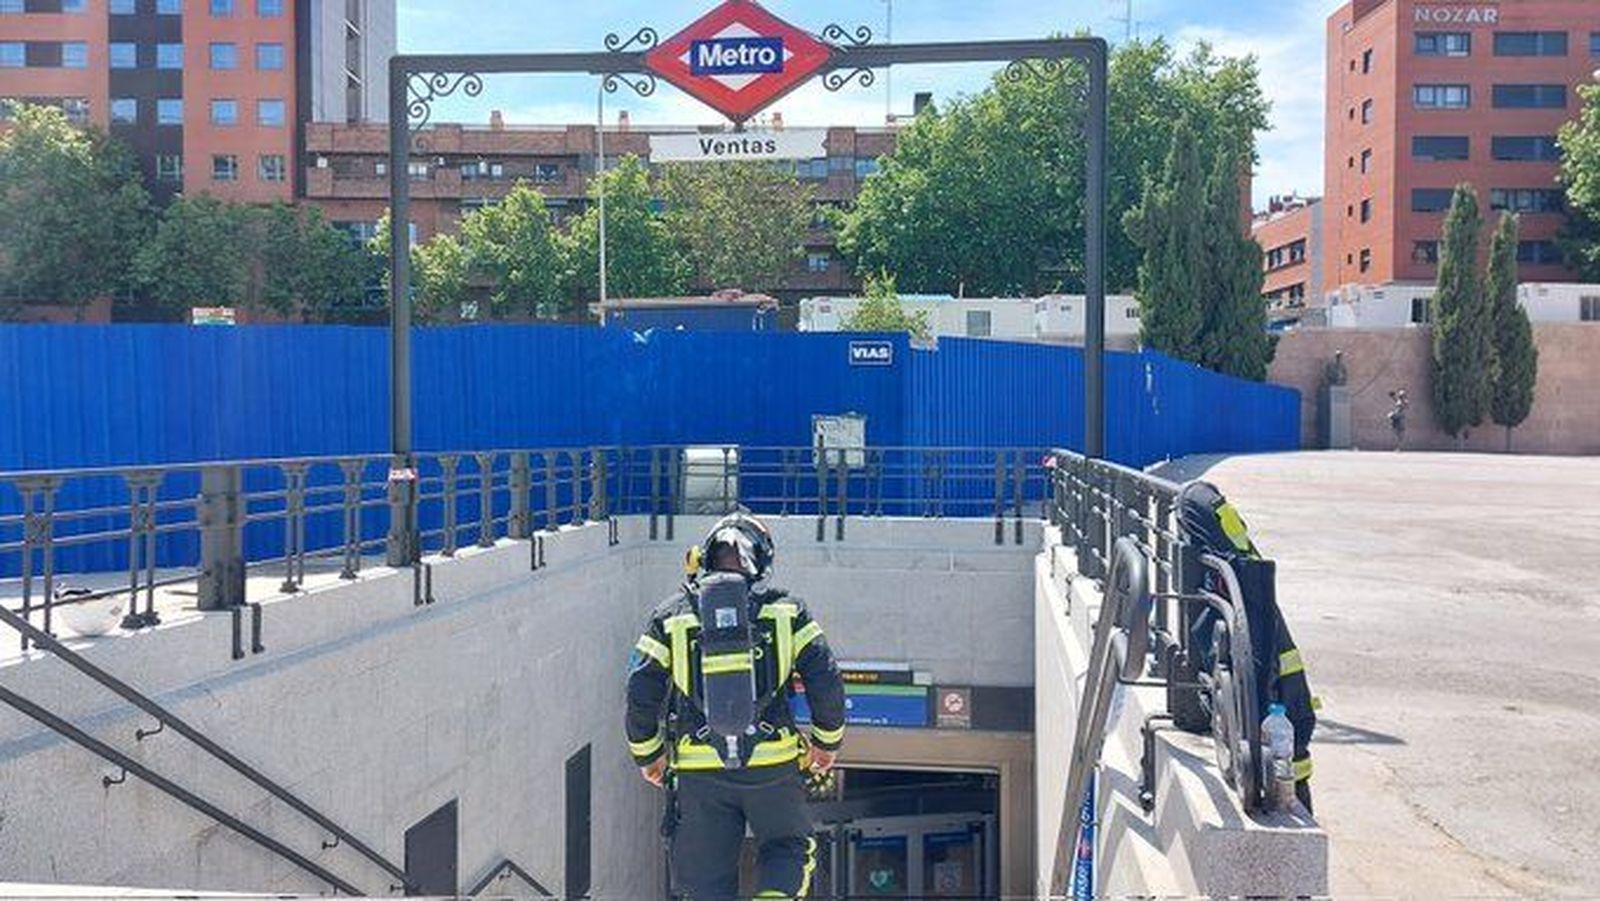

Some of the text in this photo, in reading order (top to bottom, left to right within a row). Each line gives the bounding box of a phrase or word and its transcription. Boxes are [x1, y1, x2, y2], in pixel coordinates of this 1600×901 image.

[1415, 7, 1498, 23] NOZAR
[699, 43, 776, 67] Metro
[700, 138, 777, 155] Ventas
[852, 347, 889, 359] VIAS
